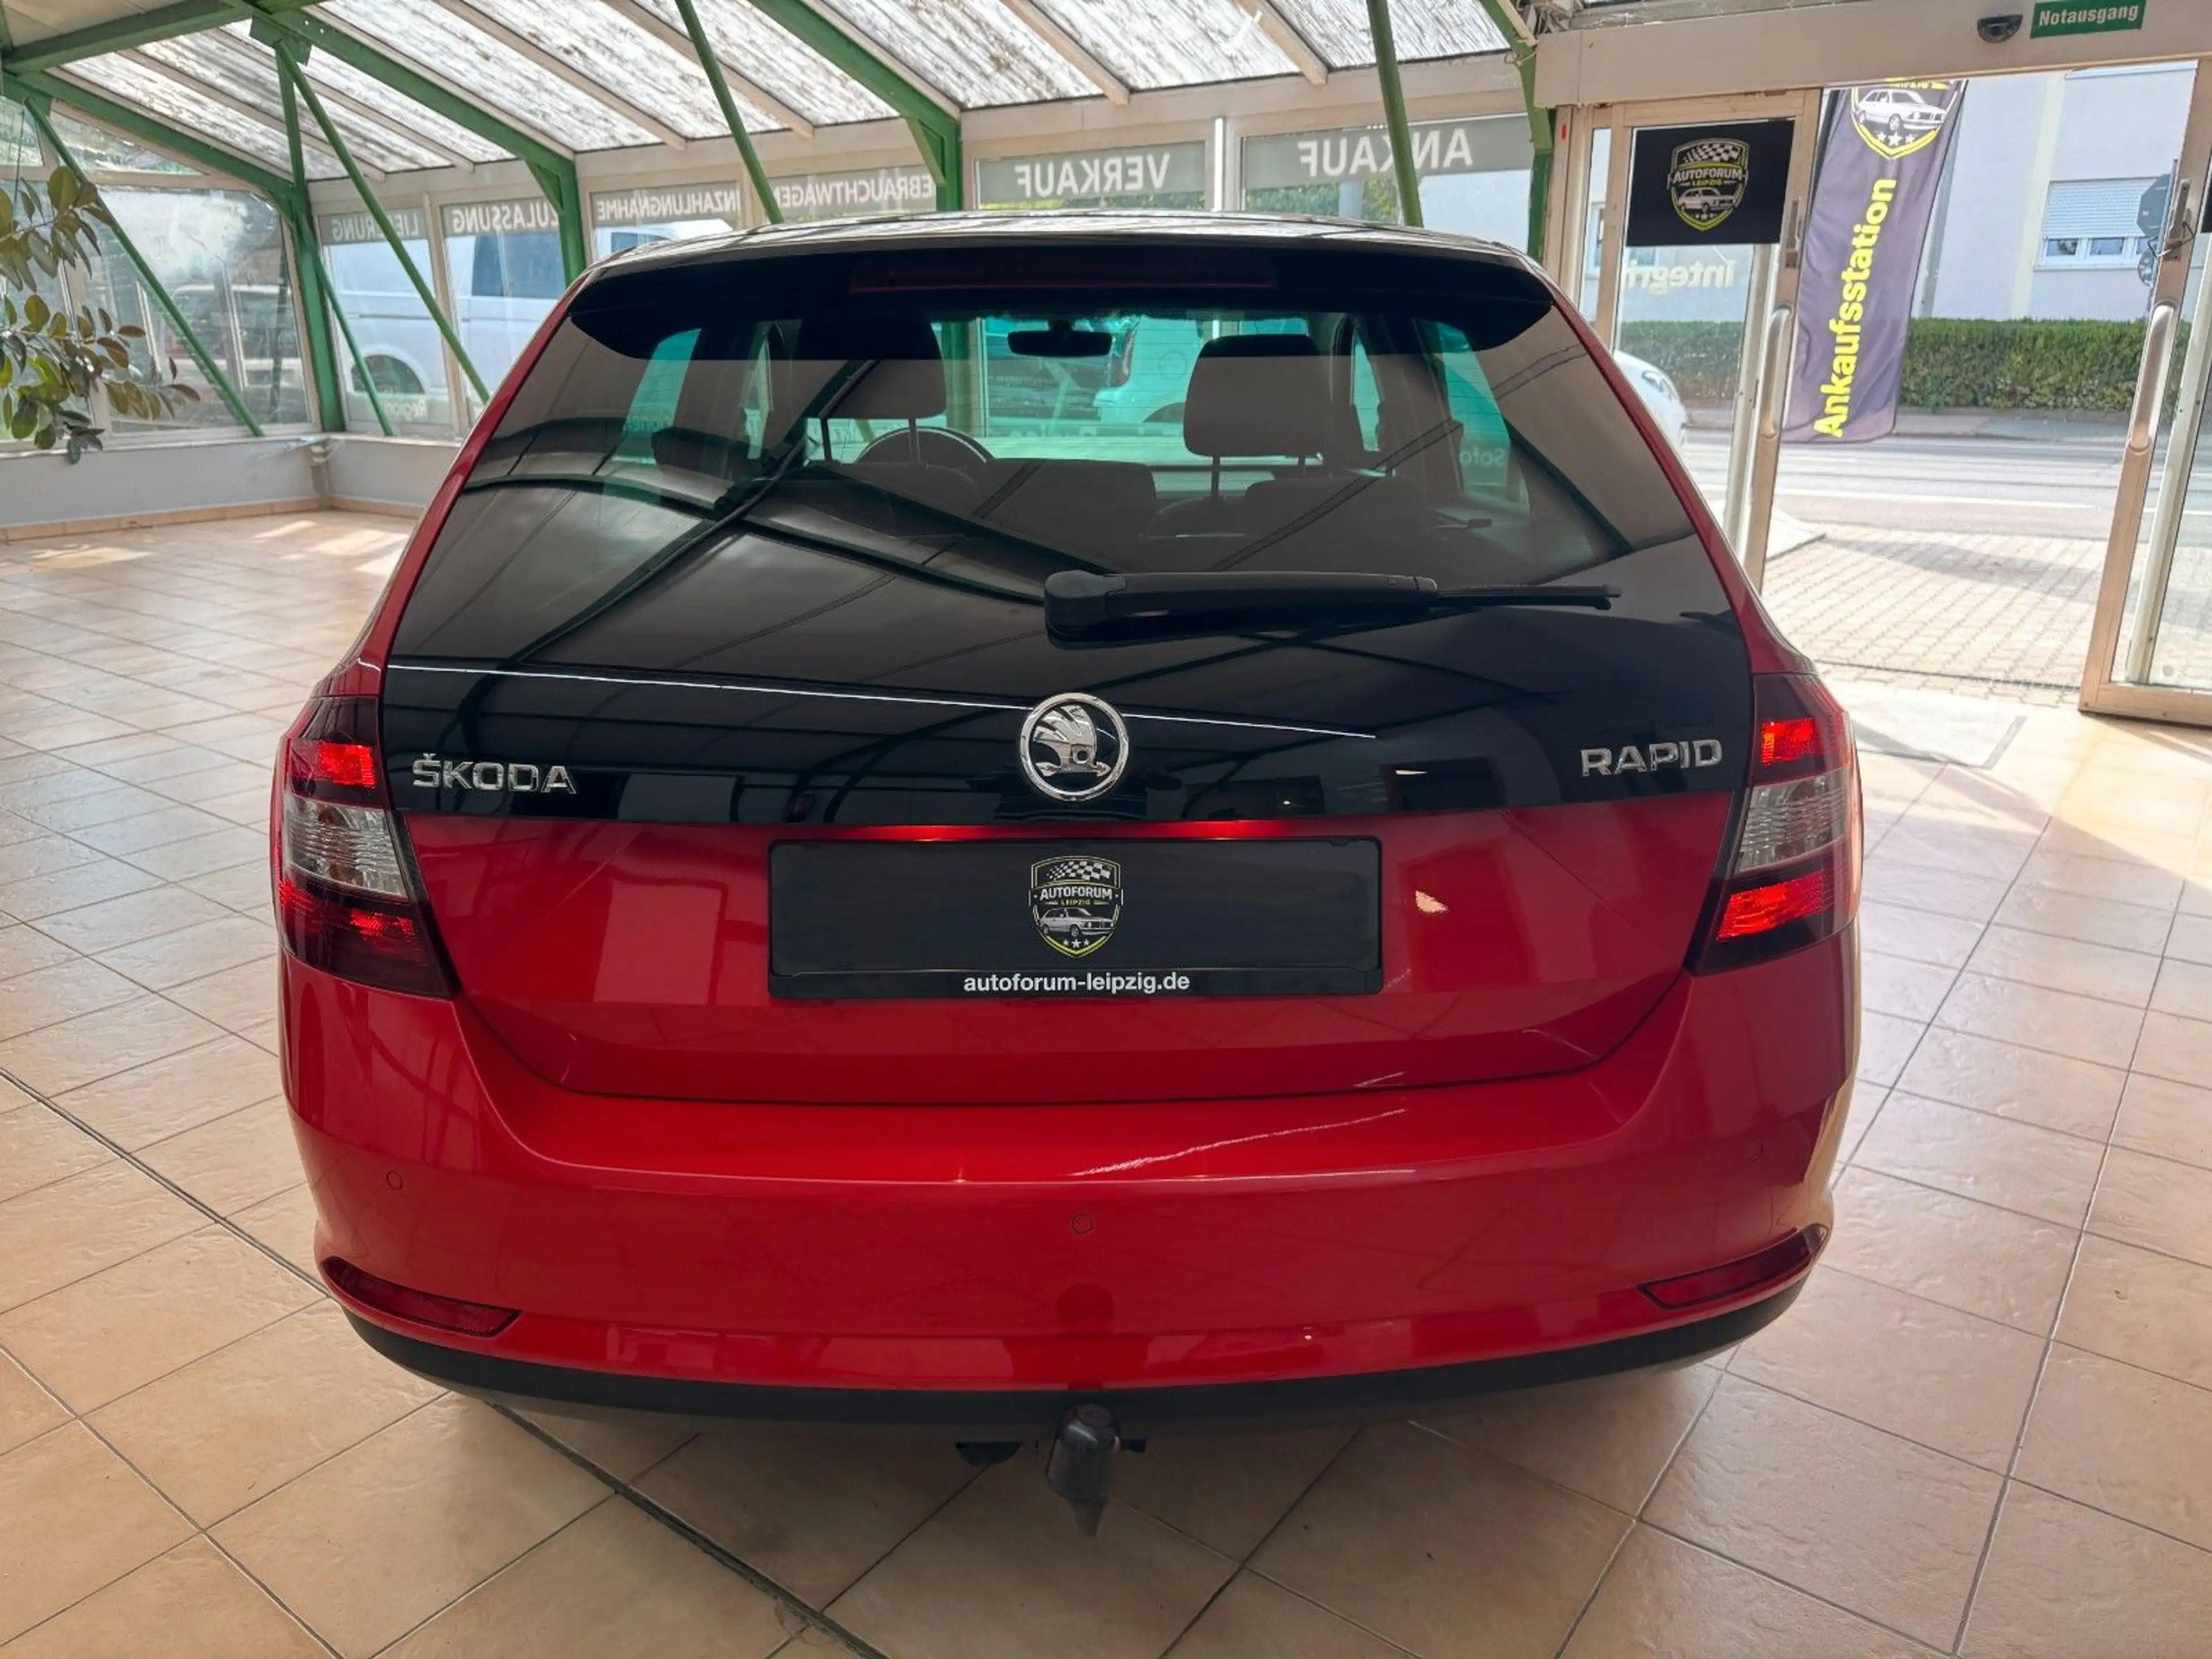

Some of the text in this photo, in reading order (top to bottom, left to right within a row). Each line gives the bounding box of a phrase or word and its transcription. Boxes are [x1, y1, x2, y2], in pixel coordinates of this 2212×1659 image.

[2039, 5, 2139, 26] Notausgang
[1673, 167, 1743, 184] AUTOFORUM
[1813, 178, 1896, 438] Ankaufsstation
[1581, 739, 1722, 777] RAPID
[412, 753, 577, 794] ŠKODA
[1040, 885, 1112, 901] AUTOFORUM
[963, 971, 1191, 994] autoforum-leipzig.de
